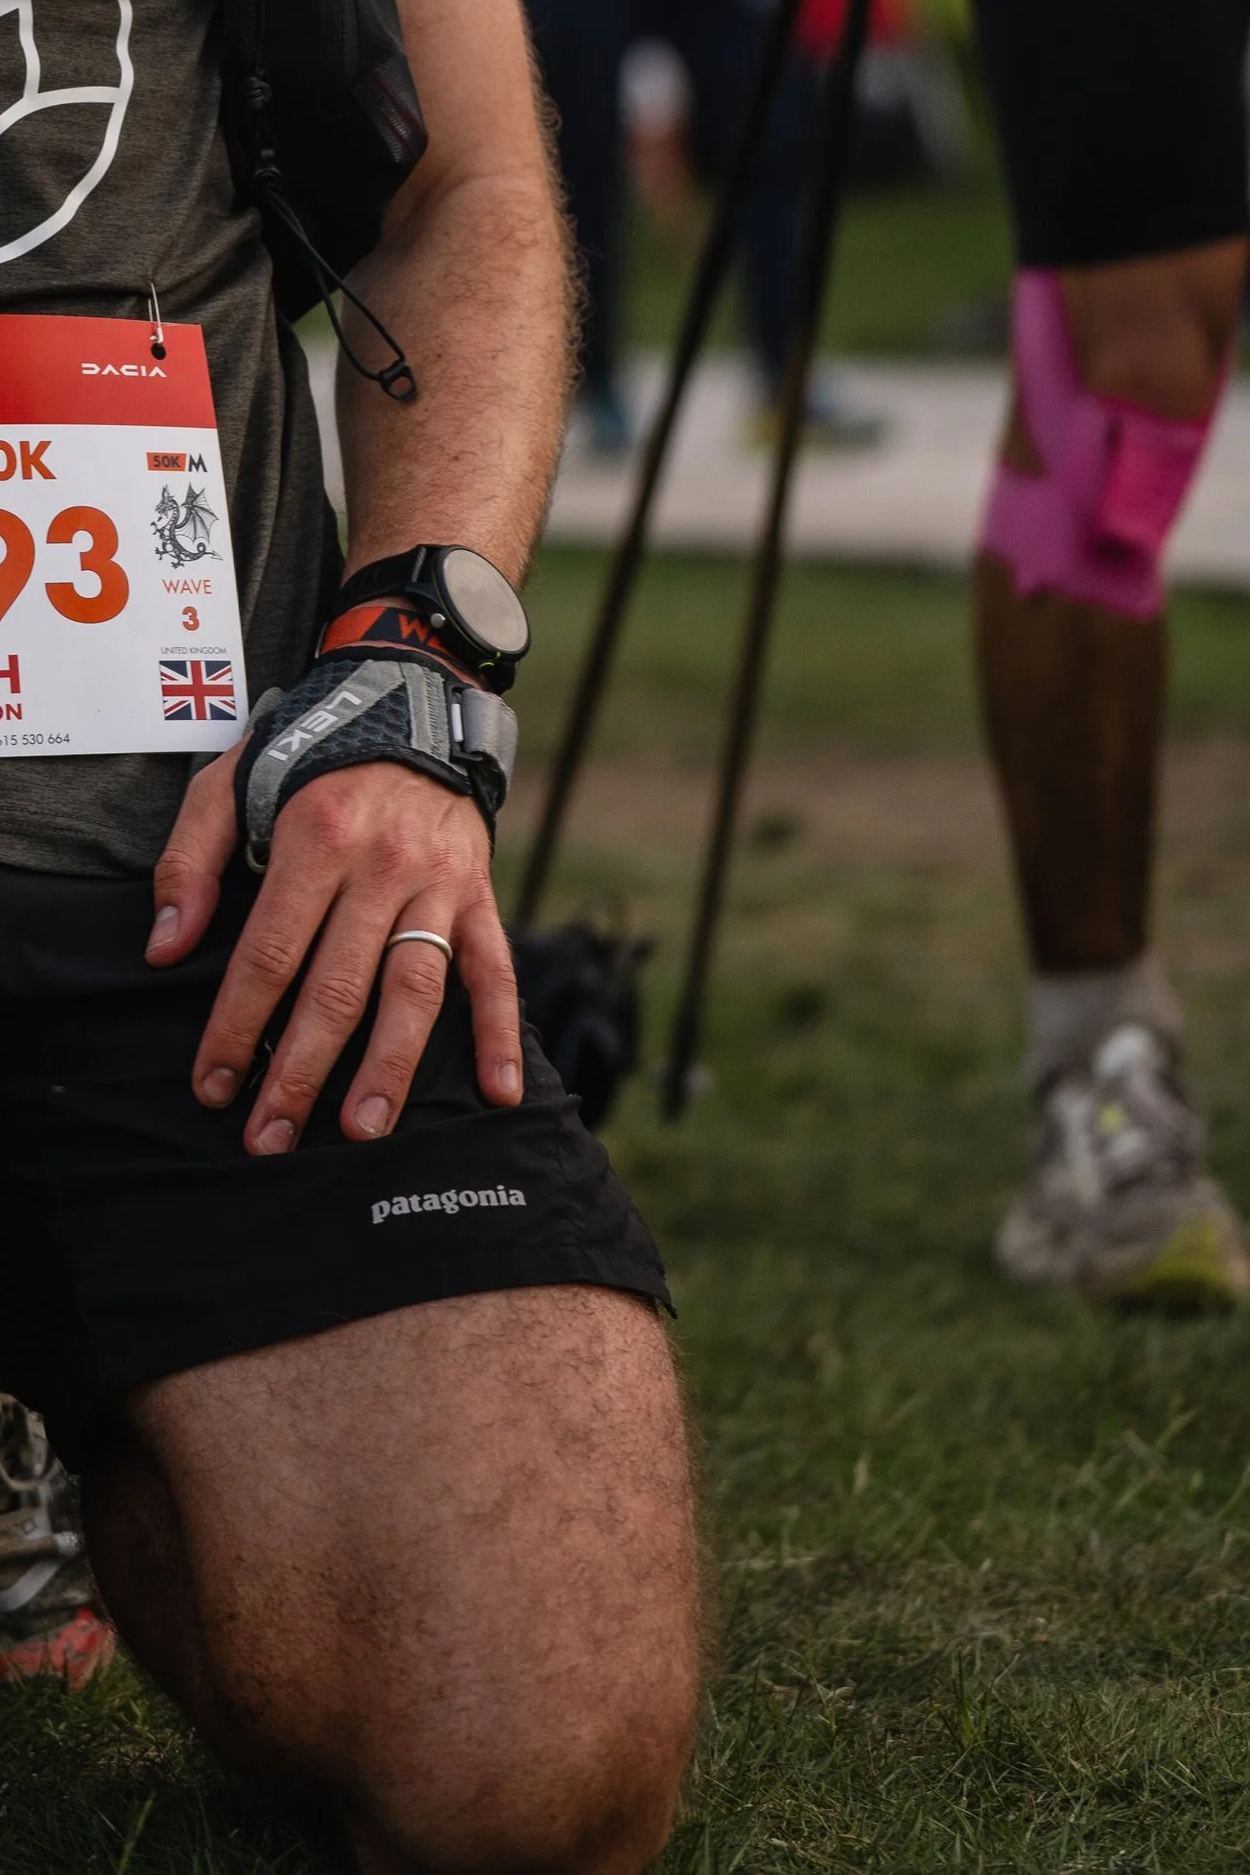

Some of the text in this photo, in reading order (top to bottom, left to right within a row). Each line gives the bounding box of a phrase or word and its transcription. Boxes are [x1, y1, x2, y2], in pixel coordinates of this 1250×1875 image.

[81, 363, 167, 378] DACIA
[153, 454, 182, 469] 50K
[162, 579, 212, 595] WAVE
[182, 606, 200, 631] 3
[160, 646, 227, 655] UNITED KINGDOM
[266, 691, 363, 762] LEKI
[22, 733, 43, 745] 530
[48, 732, 71, 744] 664
[371, 1184, 527, 1224] patagonia
